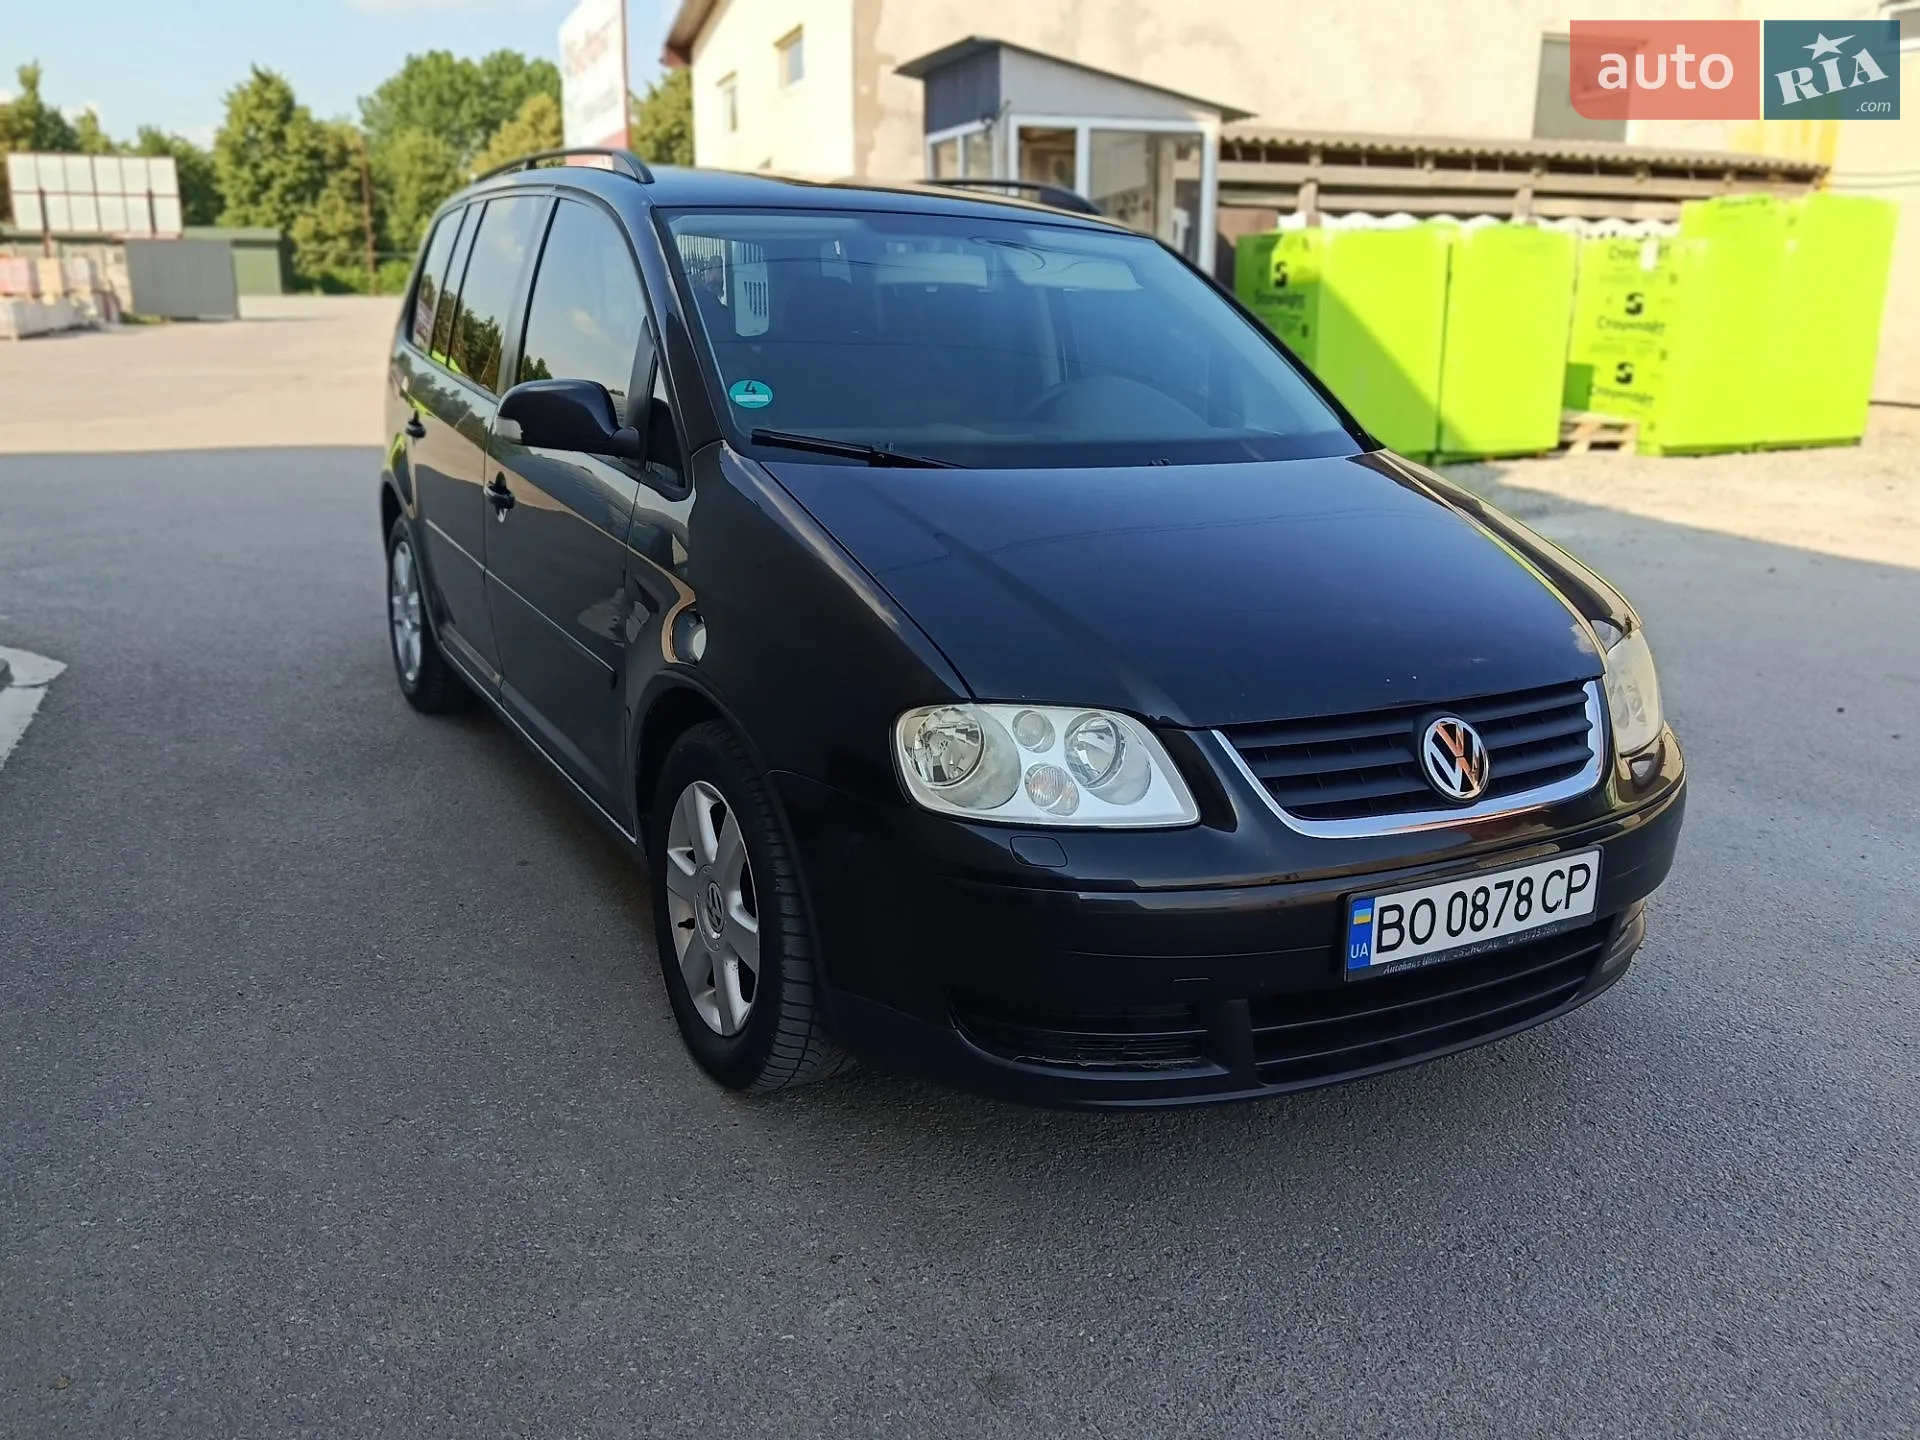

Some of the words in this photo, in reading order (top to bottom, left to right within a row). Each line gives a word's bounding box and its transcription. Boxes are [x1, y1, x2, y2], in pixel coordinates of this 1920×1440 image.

[744, 381, 757, 394] 4
[1376, 898, 1436, 953] BO
[1446, 876, 1534, 938] 0878
[1541, 863, 1591, 913] CP
[1350, 941, 1369, 959] UA
